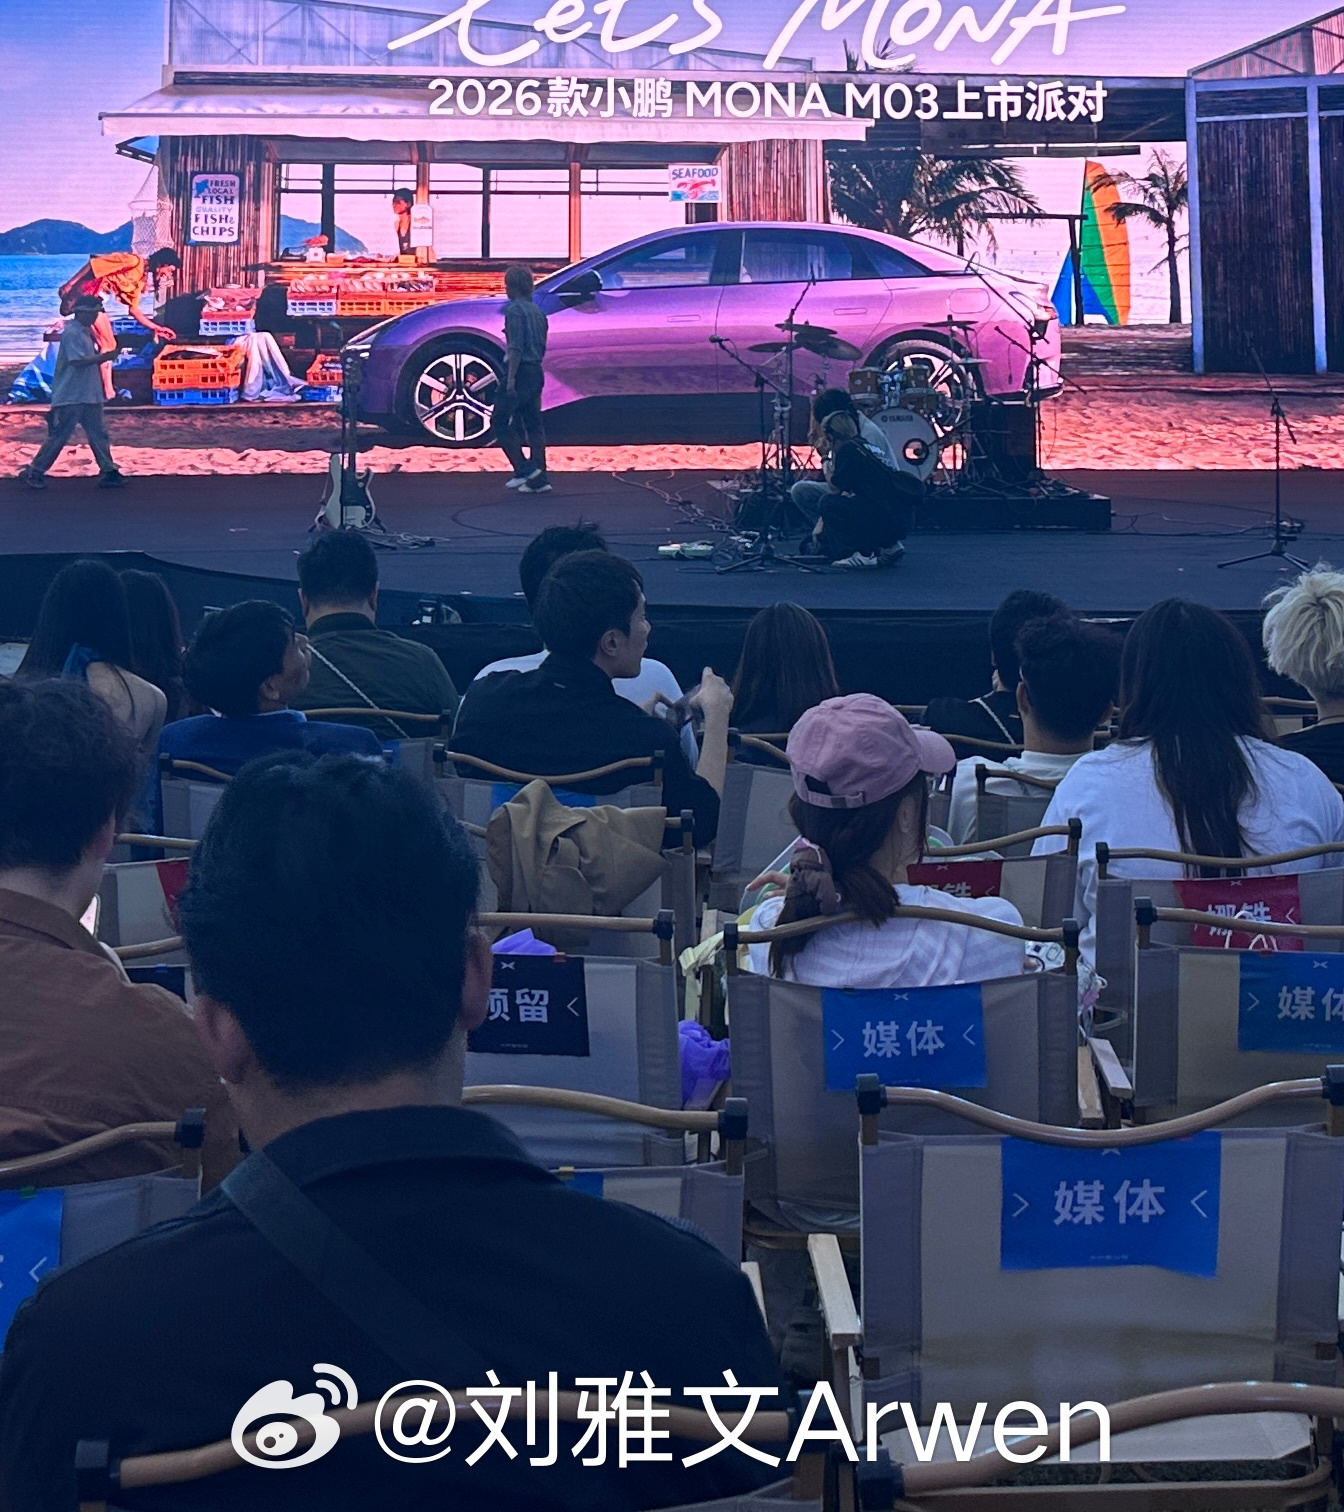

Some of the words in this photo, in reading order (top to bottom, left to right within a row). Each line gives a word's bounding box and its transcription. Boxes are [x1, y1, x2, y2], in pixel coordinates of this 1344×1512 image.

[428, 77, 669, 119] 2026款小鹏
[686, 80, 831, 118] MONA
[845, 79, 1106, 123] M03上市派对
[672, 168, 718, 180] SEAFOOD
[202, 195, 234, 204] FISH
[192, 226, 235, 236] CHIPS
[862, 1019, 945, 1058] 媒体
[1054, 1179, 1165, 1226] 媒体
